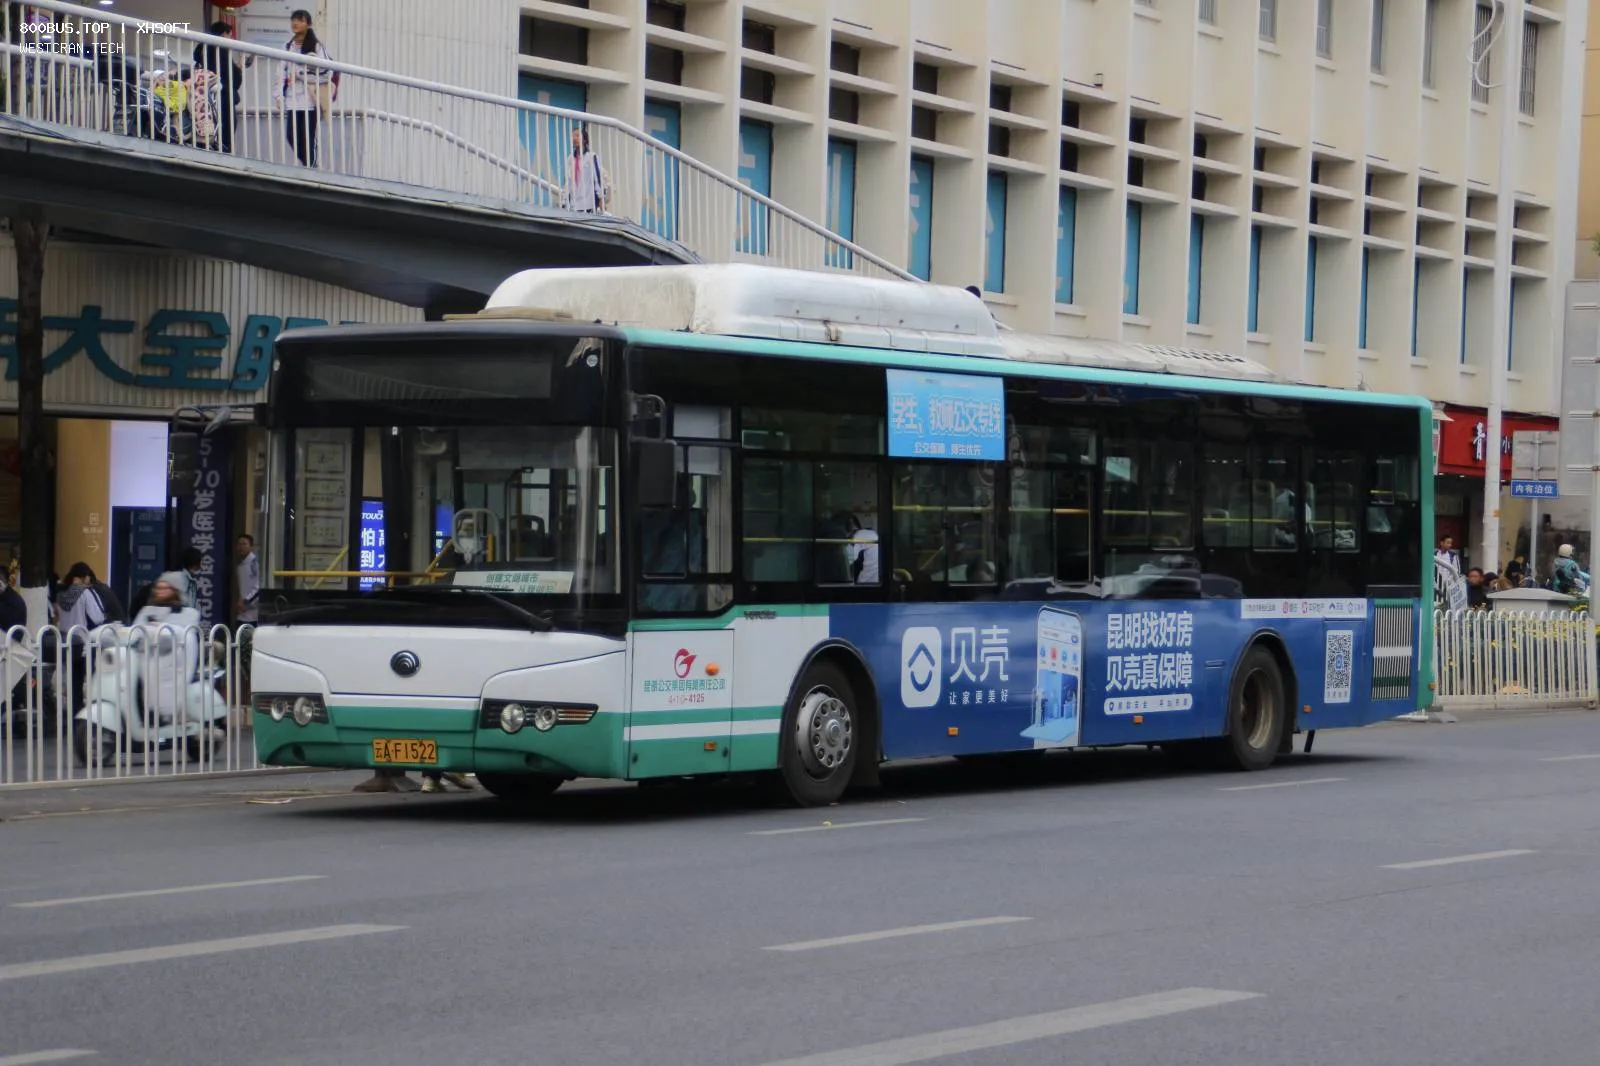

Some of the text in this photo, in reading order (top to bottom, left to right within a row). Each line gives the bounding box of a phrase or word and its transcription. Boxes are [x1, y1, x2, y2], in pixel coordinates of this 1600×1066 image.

[1515, 483, 1554, 494] 内有泊位
[1106, 610, 1193, 649] 昆明找好房
[949, 624, 1010, 684] 贝壳
[1105, 650, 1193, 692] 贝壳真保障
[949, 687, 1009, 706] 让家更美好
